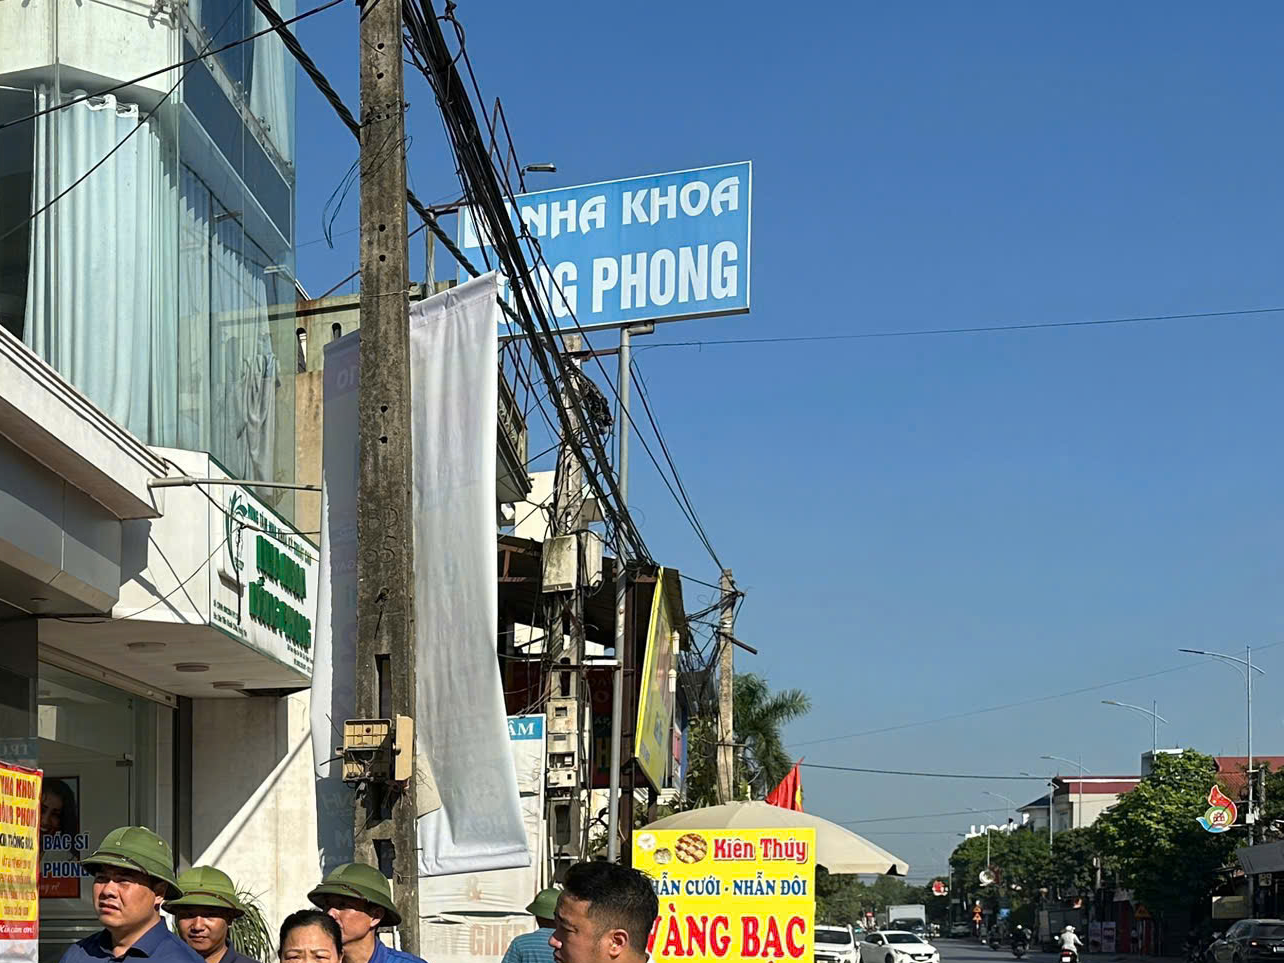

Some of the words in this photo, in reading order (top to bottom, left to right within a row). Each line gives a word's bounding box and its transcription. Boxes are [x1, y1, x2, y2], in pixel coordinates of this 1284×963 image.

[521, 195, 606, 239] NHA
[622, 176, 740, 225] KHOA
[592, 241, 738, 313] PHONG
[508, 720, 535, 736] ÂM
[43, 831, 71, 850] BÁC
[651, 872, 681, 895] HẪN
[685, 875, 720, 895] CƯỚI
[733, 871, 776, 896] NHẪN
[780, 875, 807, 896] ĐÔI
